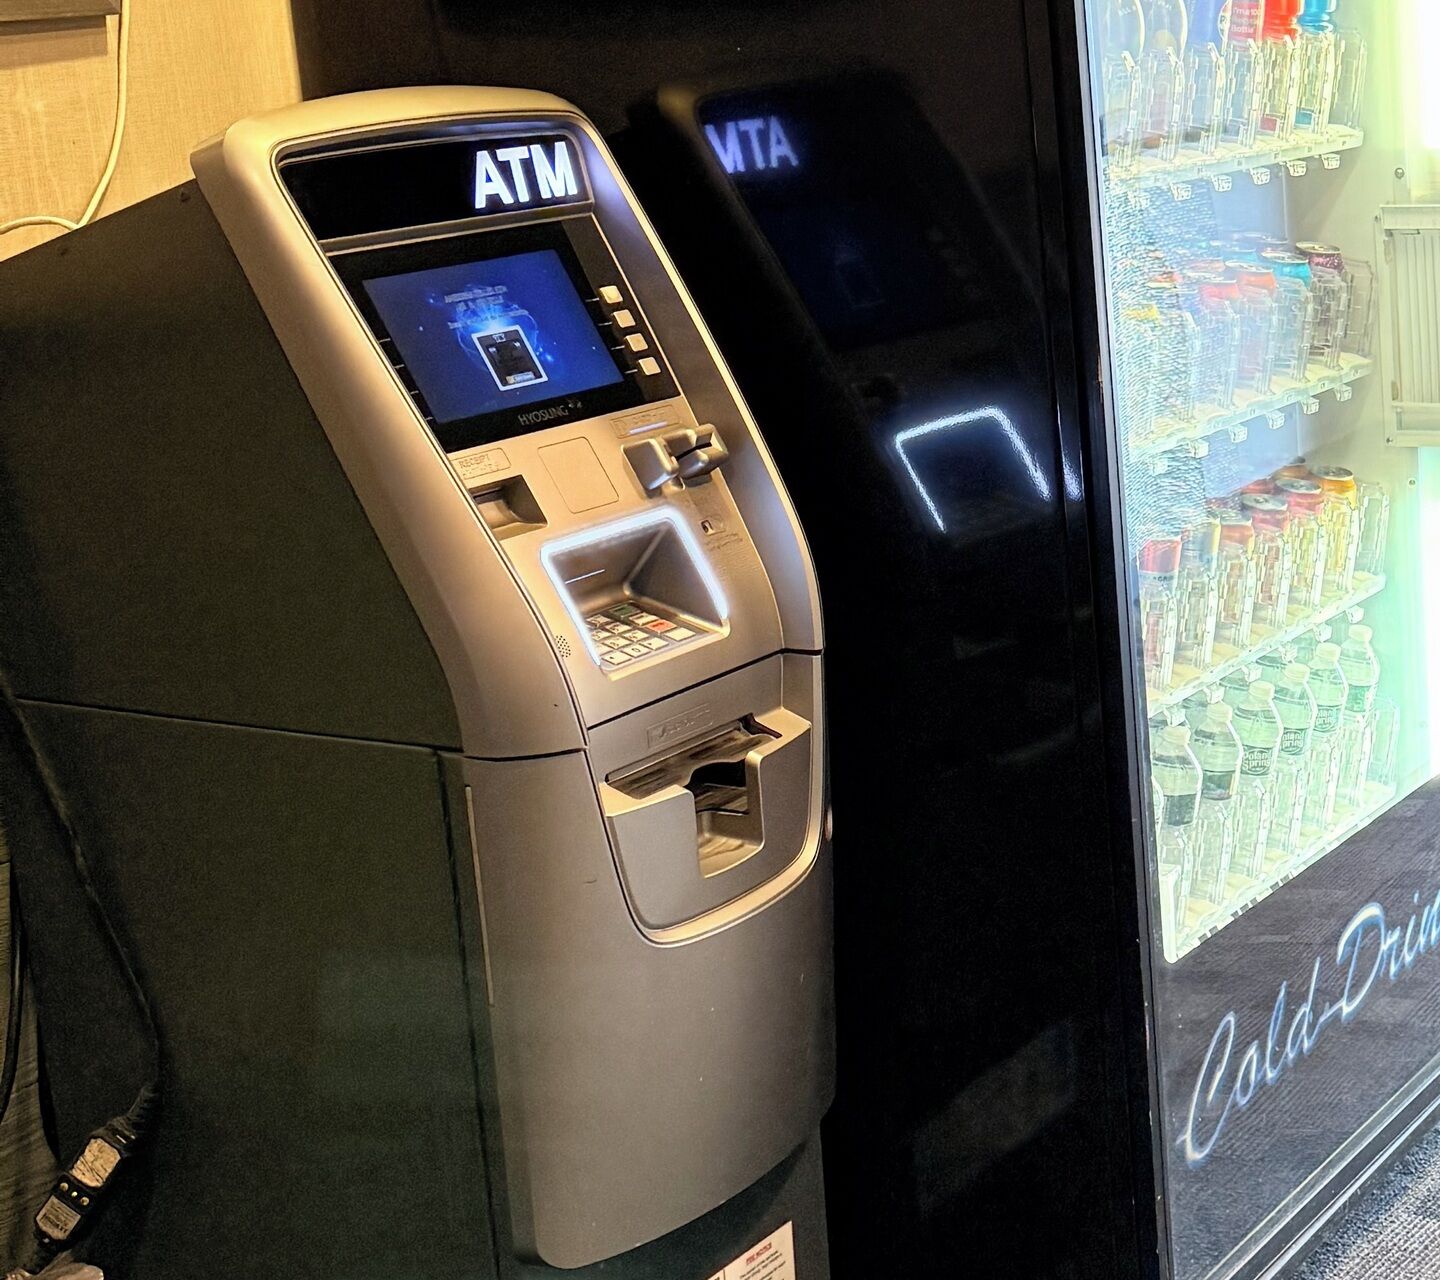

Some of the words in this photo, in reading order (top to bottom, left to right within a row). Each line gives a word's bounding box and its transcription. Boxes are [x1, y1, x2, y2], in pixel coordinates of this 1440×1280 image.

[474, 141, 578, 209] ATM
[518, 406, 569, 426] HYOSUNG
[1282, 731, 1304, 740] oland
[1282, 739, 1304, 749] pring
[1176, 956, 1322, 1169] Cold
